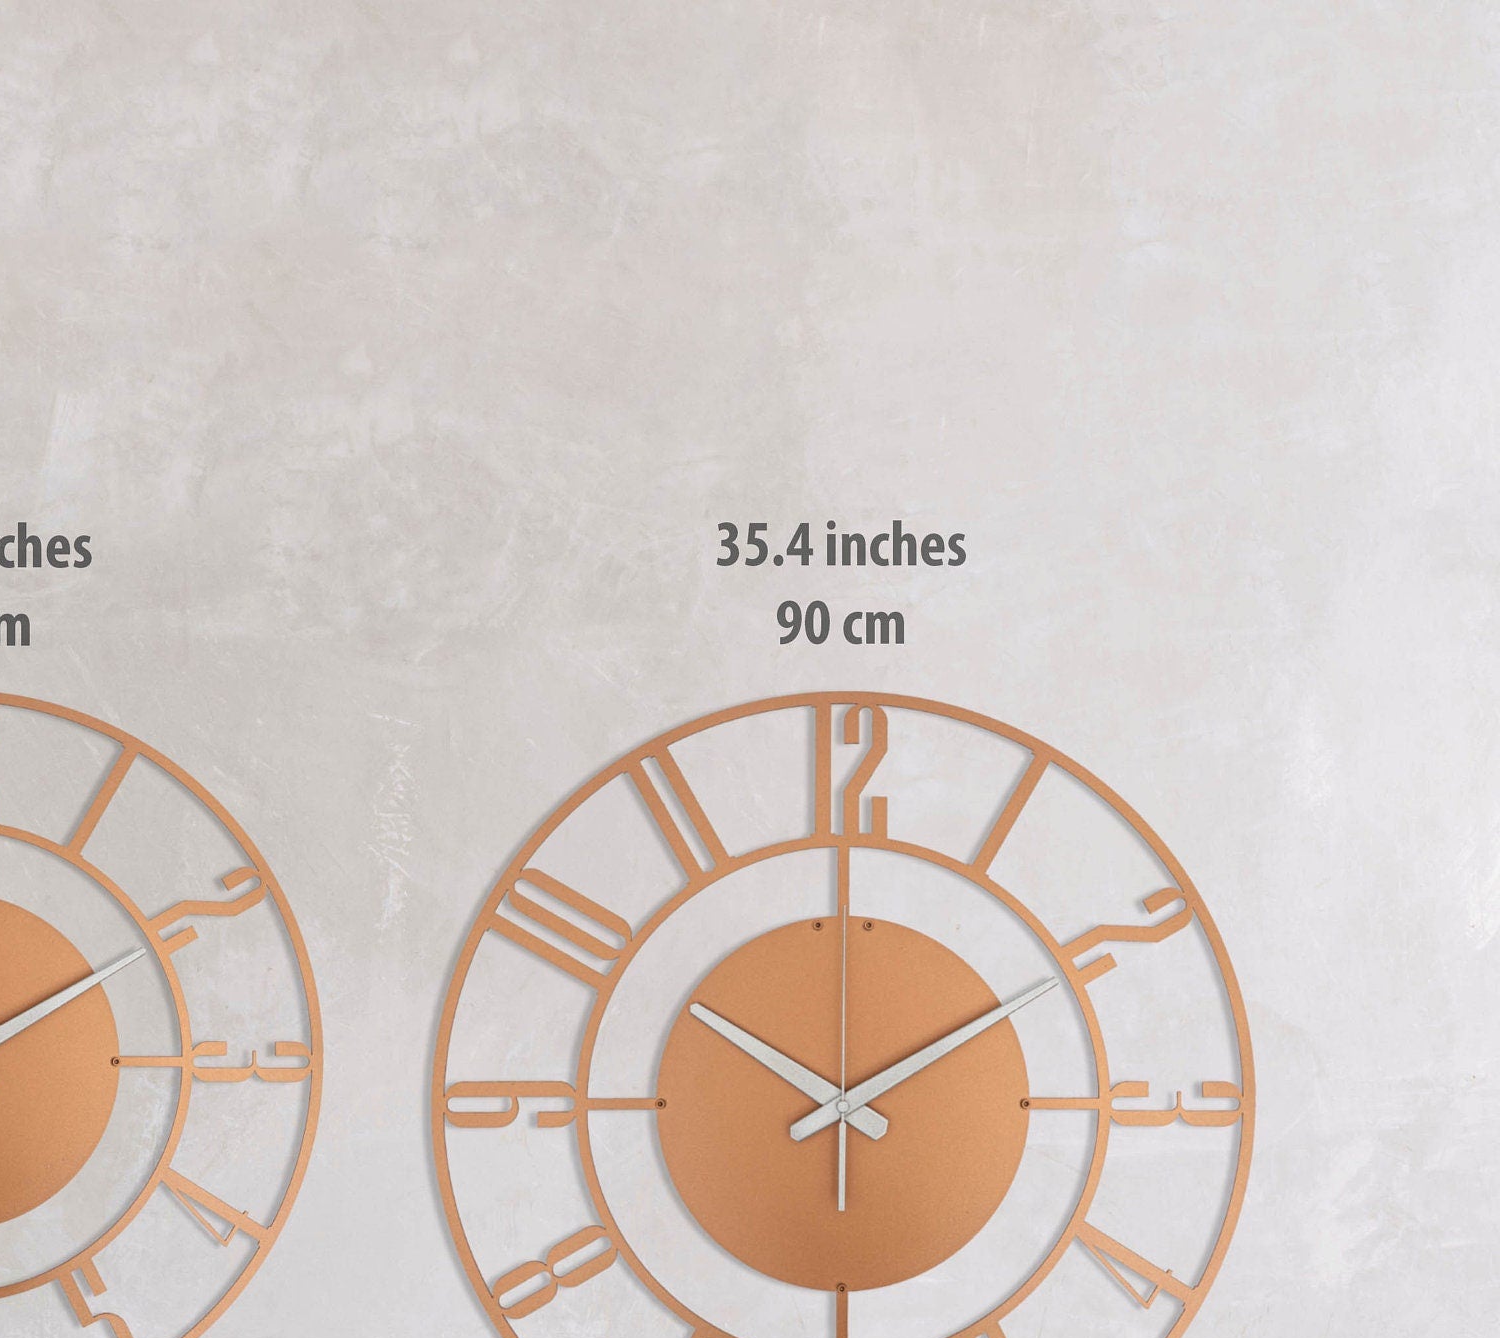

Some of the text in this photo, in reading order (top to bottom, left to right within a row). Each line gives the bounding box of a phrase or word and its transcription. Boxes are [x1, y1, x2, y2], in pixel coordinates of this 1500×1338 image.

[625, 742, 733, 880] 11
[813, 702, 889, 838] 12
[147, 866, 266, 952] 2
[487, 868, 633, 991] 10
[1060, 887, 1192, 983] 2
[191, 1040, 313, 1083] 3
[444, 1080, 578, 1128] 9
[1109, 1080, 1244, 1128] 3
[160, 1164, 267, 1247] 4
[492, 1227, 619, 1320] 8
[1074, 1218, 1193, 1310] 4
